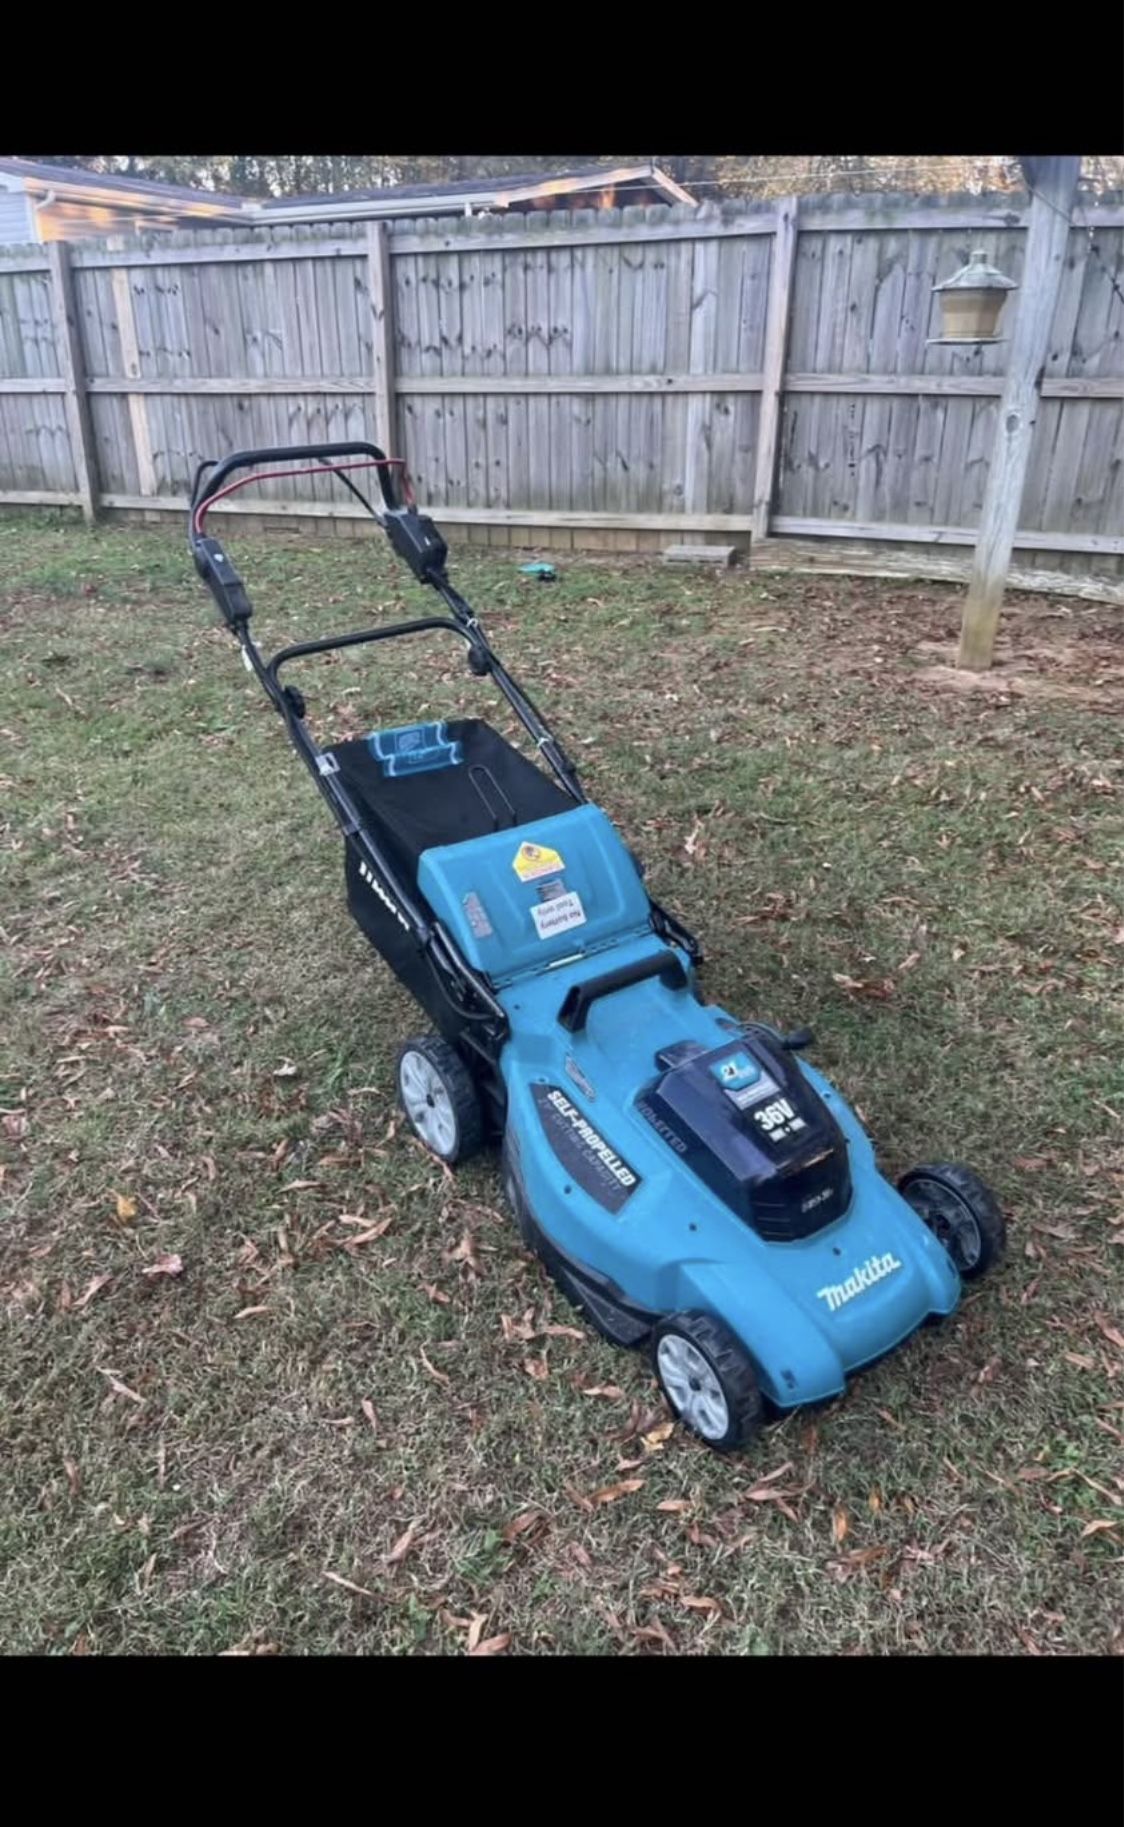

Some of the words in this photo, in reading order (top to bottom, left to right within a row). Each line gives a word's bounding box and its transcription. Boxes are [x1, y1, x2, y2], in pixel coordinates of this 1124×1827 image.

[547, 1090, 637, 1187] SELF-PROPELLED
[753, 1097, 796, 1132] 36V
[817, 1252, 902, 1312] Makita
